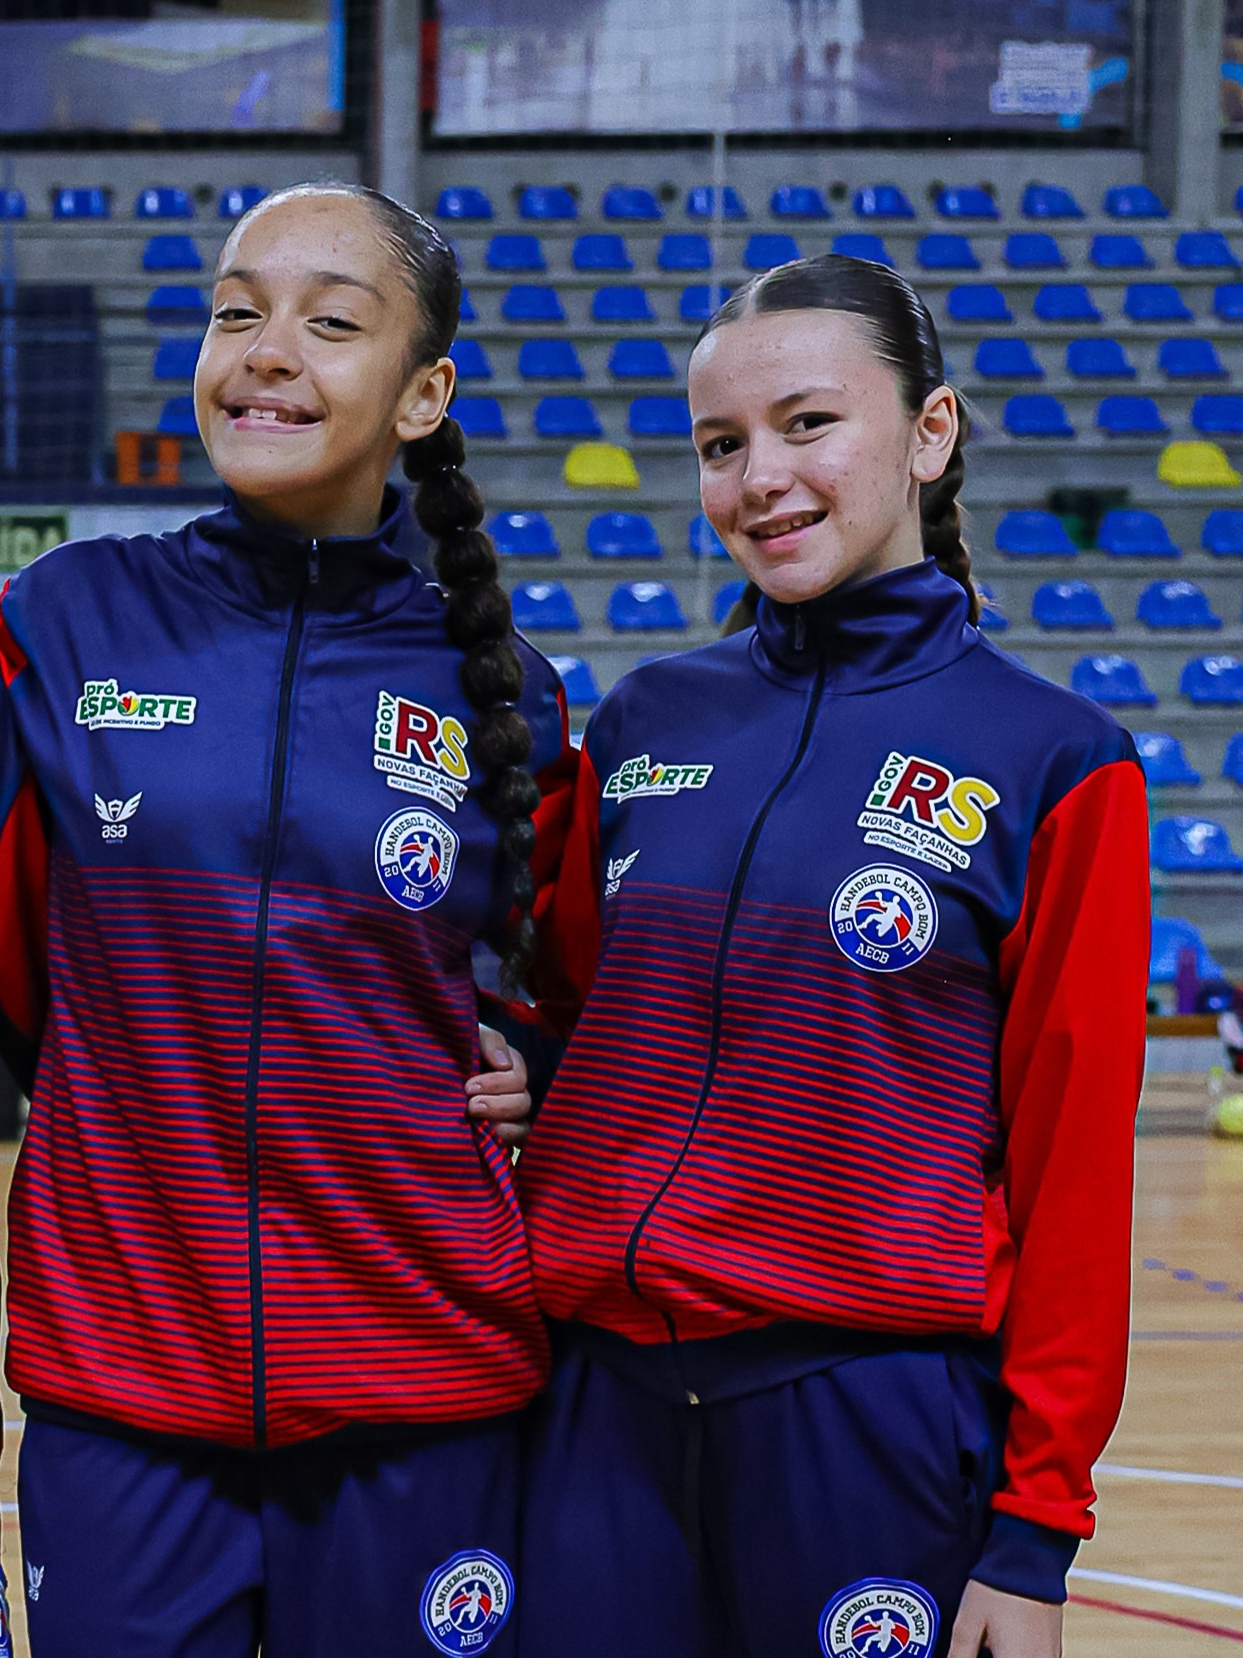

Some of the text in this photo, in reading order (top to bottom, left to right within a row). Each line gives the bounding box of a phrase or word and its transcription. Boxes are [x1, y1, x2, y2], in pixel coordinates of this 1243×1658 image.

[87, 682, 114, 696] pró
[80, 695, 192, 721] ESPORTE
[395, 700, 467, 777] RS
[377, 758, 416, 776] NOVAS
[621, 757, 647, 774] pró
[606, 767, 709, 795] ESPORTE
[887, 759, 996, 841] RS
[101, 823, 128, 839] asa
[384, 816, 424, 857] HANDEBOL
[425, 818, 453, 850] CAMPO
[861, 814, 968, 866] NOVAS FAÇANHAS
[868, 833, 879, 842] NO
[880, 836, 916, 854] ESPORTE
[384, 864, 399, 878] 20
[839, 873, 929, 940] HANDEBOL CAMPO BOM
[837, 920, 854, 935] 20
[855, 942, 890, 965] AECB
[901, 942, 914, 956] 11
[435, 1568, 470, 1617] HANDEBOL
[471, 1565, 499, 1584] CAMPO
[437, 1621, 453, 1637] 20
[835, 1594, 926, 1645] HANDEBOL CAMPO BOM
[908, 1644, 920, 1656] 11
